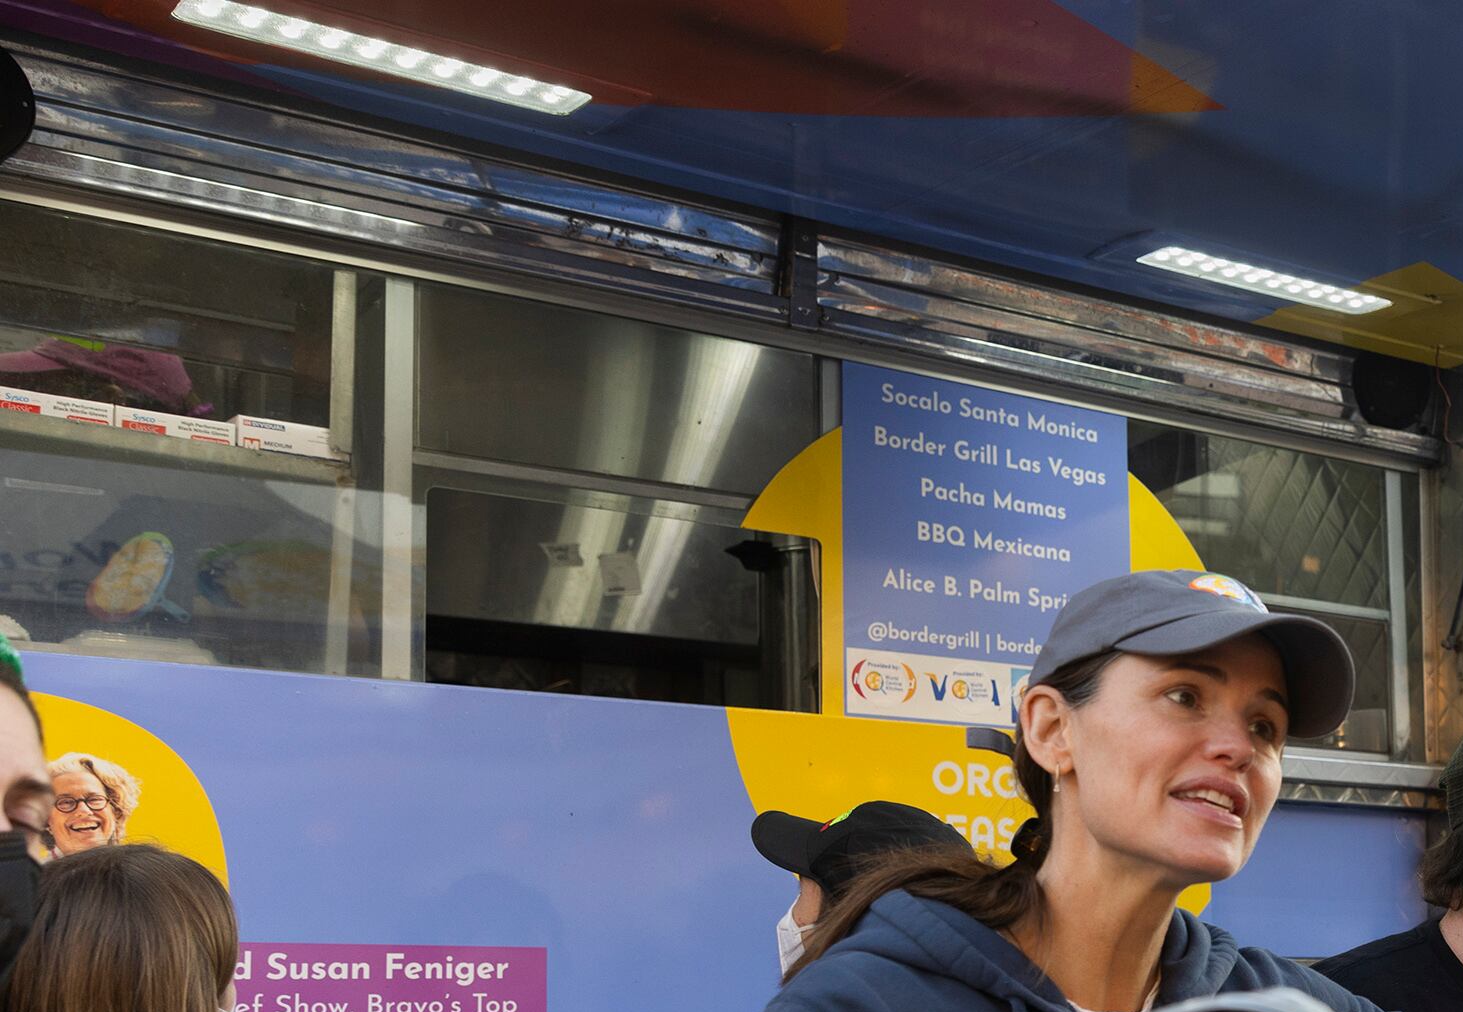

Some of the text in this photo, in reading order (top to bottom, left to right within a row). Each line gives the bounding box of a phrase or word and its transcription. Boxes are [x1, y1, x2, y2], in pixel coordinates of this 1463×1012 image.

[881, 383, 1098, 443] Socalo Santa Monica
[874, 425, 1106, 487] Border Grill Las Vegas
[921, 477, 1067, 520] Pacha Mamas
[917, 520, 1071, 562] BBQ Mexicana
[882, 568, 1069, 612] Alice B. Palm Spri
[867, 621, 979, 650] @bordergrill
[997, 634, 1042, 655] borde
[932, 760, 1018, 799] ORG
[233, 951, 509, 987] d Susan Feniger
